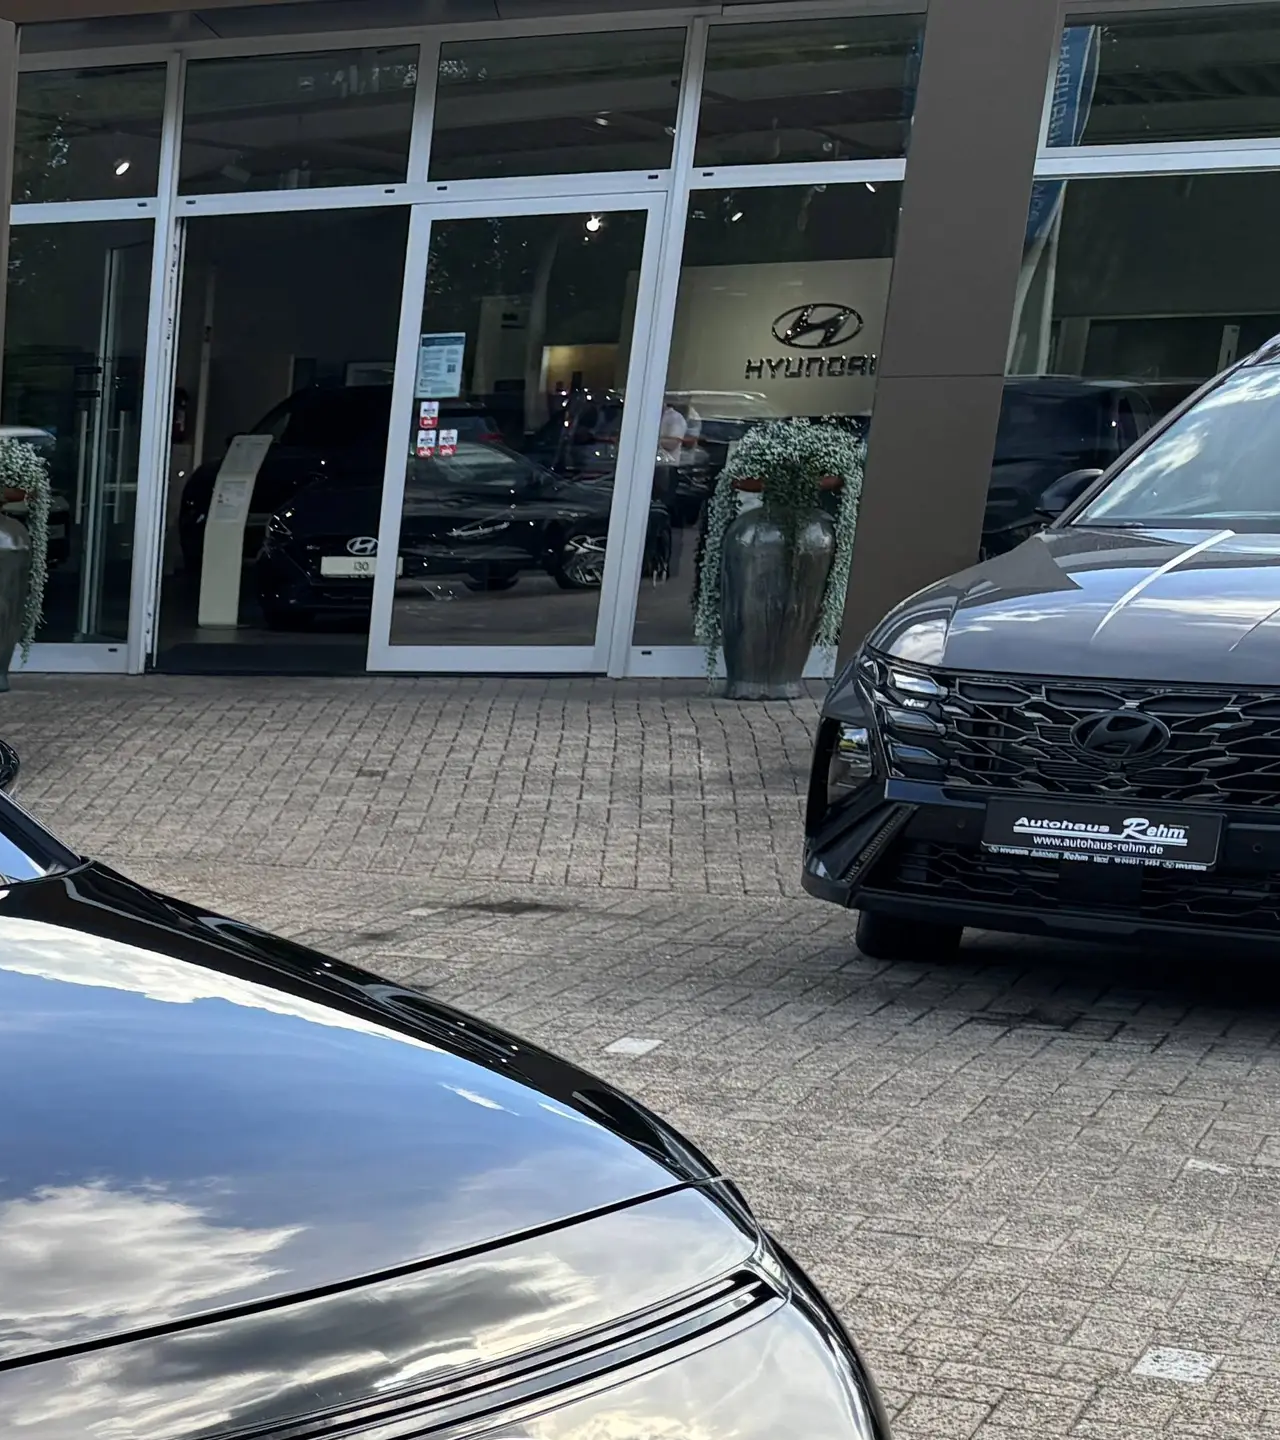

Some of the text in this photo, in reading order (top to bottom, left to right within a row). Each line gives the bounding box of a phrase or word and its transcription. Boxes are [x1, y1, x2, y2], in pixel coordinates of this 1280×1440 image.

[744, 354, 878, 380] HYUNDAI
[1014, 816, 1187, 839] Autohaus Rehm
[1032, 836, 1164, 855] www.autohaus-rehm.de
